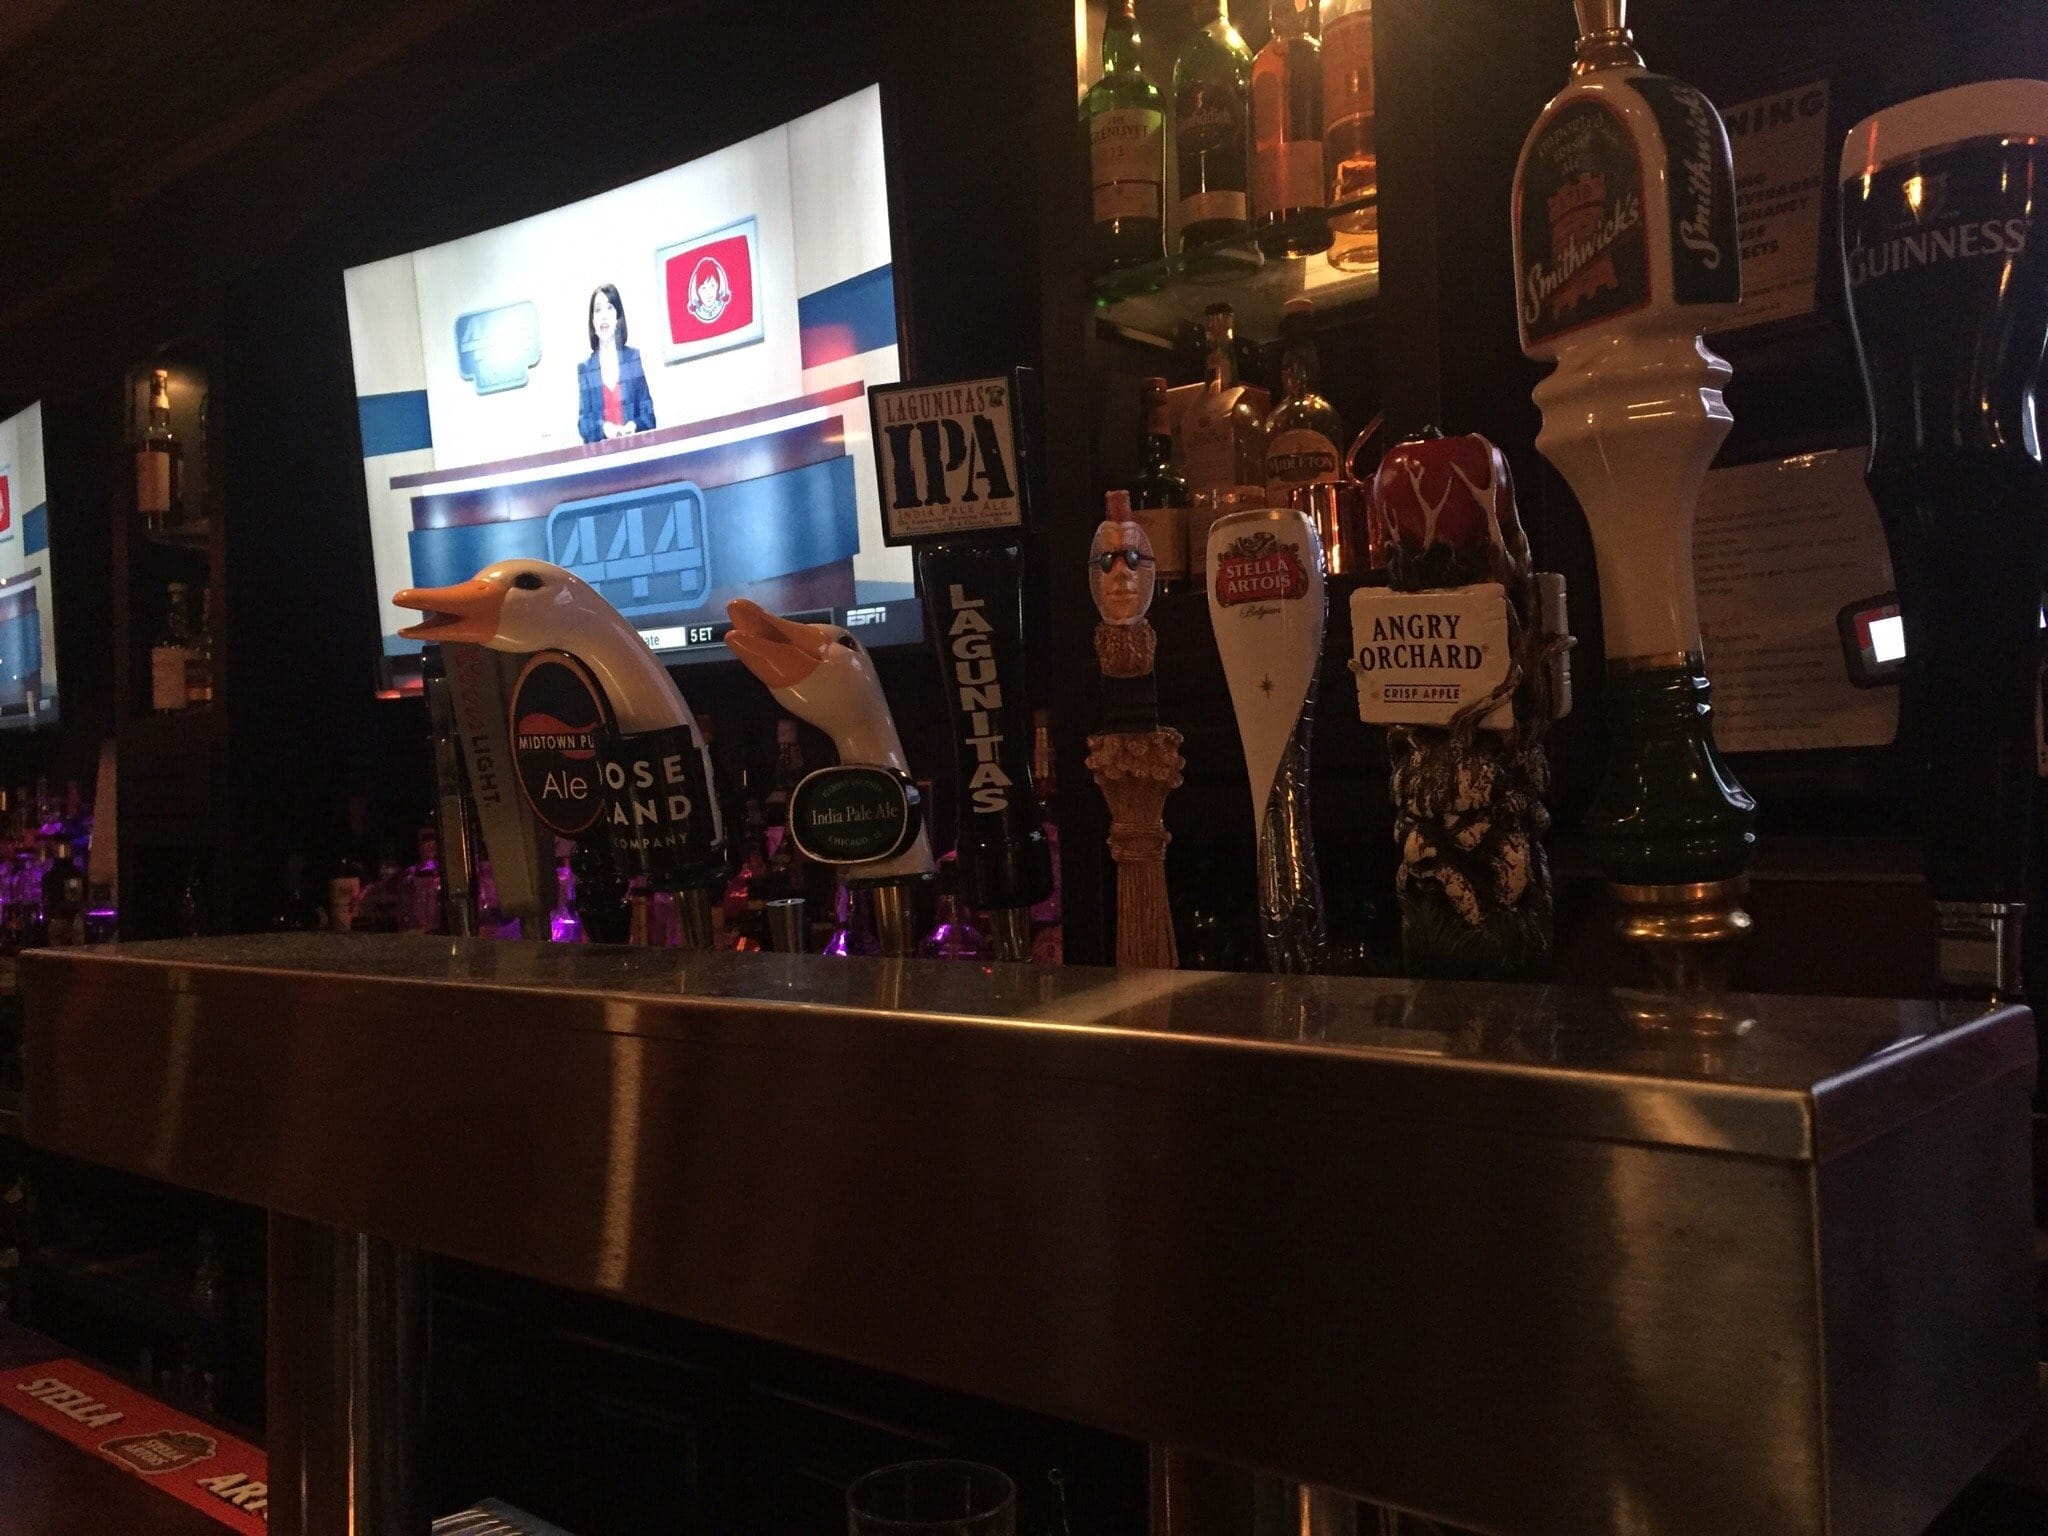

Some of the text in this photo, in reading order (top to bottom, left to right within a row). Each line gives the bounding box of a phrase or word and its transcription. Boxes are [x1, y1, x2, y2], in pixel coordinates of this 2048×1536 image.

[1726, 90, 1824, 136] NING
[1525, 192, 1639, 323] Smithwick's
[1849, 218, 2026, 286] GUINNESS
[885, 386, 986, 423] LAGUNITAS
[884, 415, 1015, 510] IPA
[942, 505, 976, 515] PALE
[983, 501, 1009, 511] ALE
[1226, 558, 1290, 579] STELLA
[1228, 574, 1292, 595] ARTOIS
[846, 607, 886, 627] ESPN
[1372, 614, 1461, 642] ANGRY
[1359, 644, 1483, 672] ORCHARD
[949, 584, 1014, 814] LAGUNITAS
[1384, 688, 1461, 700] CRISP APPLE
[518, 734, 596, 751] MIDTOWN PL
[471, 734, 501, 804] LIGHT
[541, 769, 589, 801] Ale
[604, 754, 686, 791] OSE
[612, 794, 693, 827] AND
[811, 800, 899, 826] India Pale Ale
[16, 1377, 124, 1430] STELLA
[196, 1472, 268, 1514] AR
